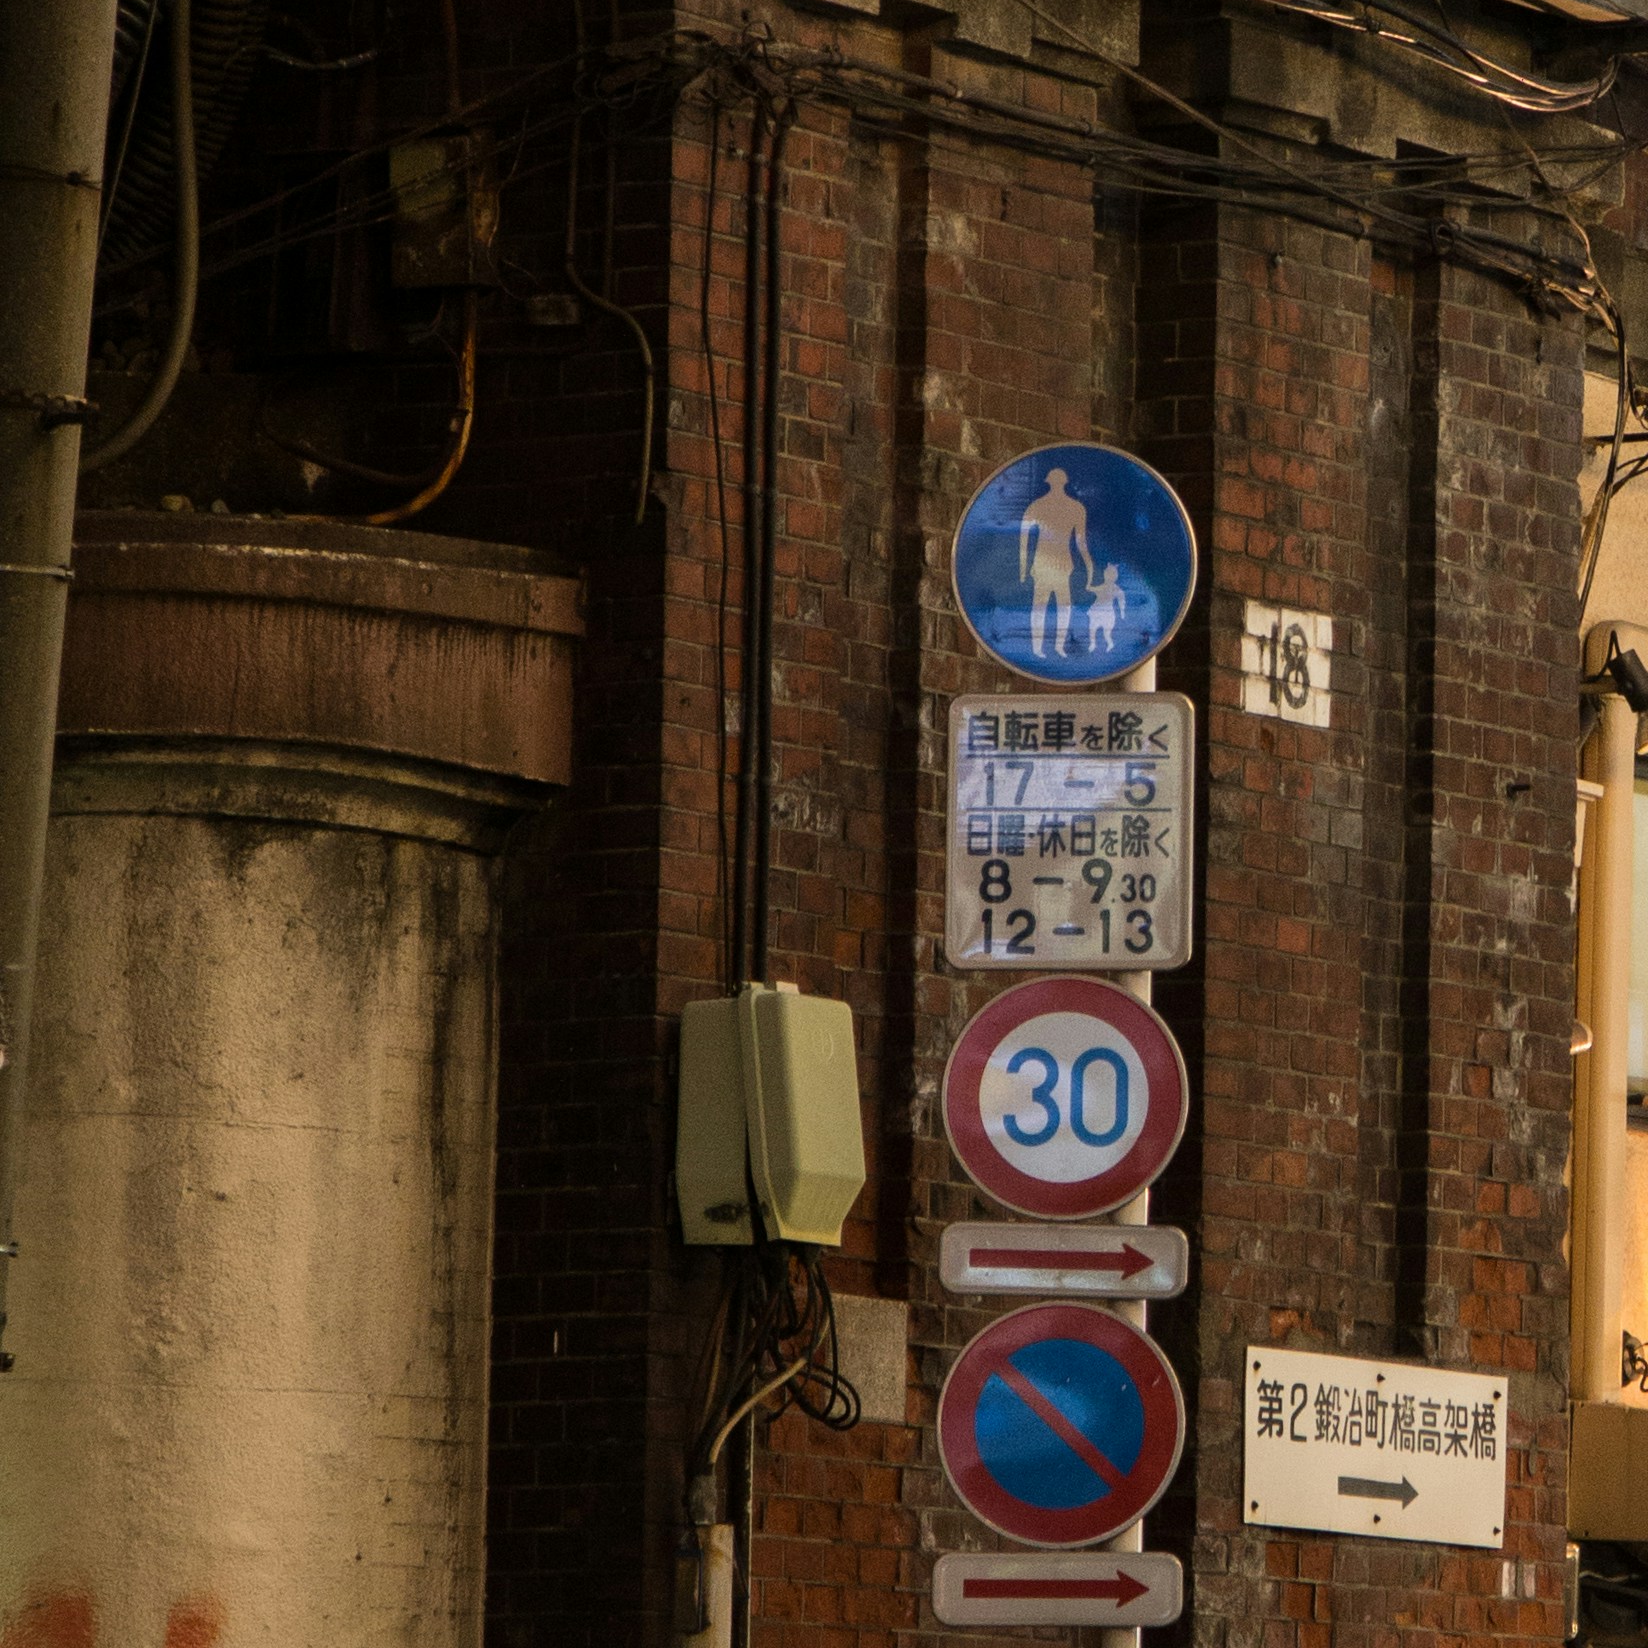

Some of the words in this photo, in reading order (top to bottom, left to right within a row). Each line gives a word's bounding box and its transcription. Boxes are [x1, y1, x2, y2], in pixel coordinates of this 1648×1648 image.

[1263, 620, 1311, 710] 18
[967, 710, 1169, 752] 自転車を除く
[967, 814, 1170, 858] 日曜・休日を除く
[1002, 1046, 1130, 1148] 30
[1256, 1378, 1497, 1462] 第2鍛冶町橋高架橋
